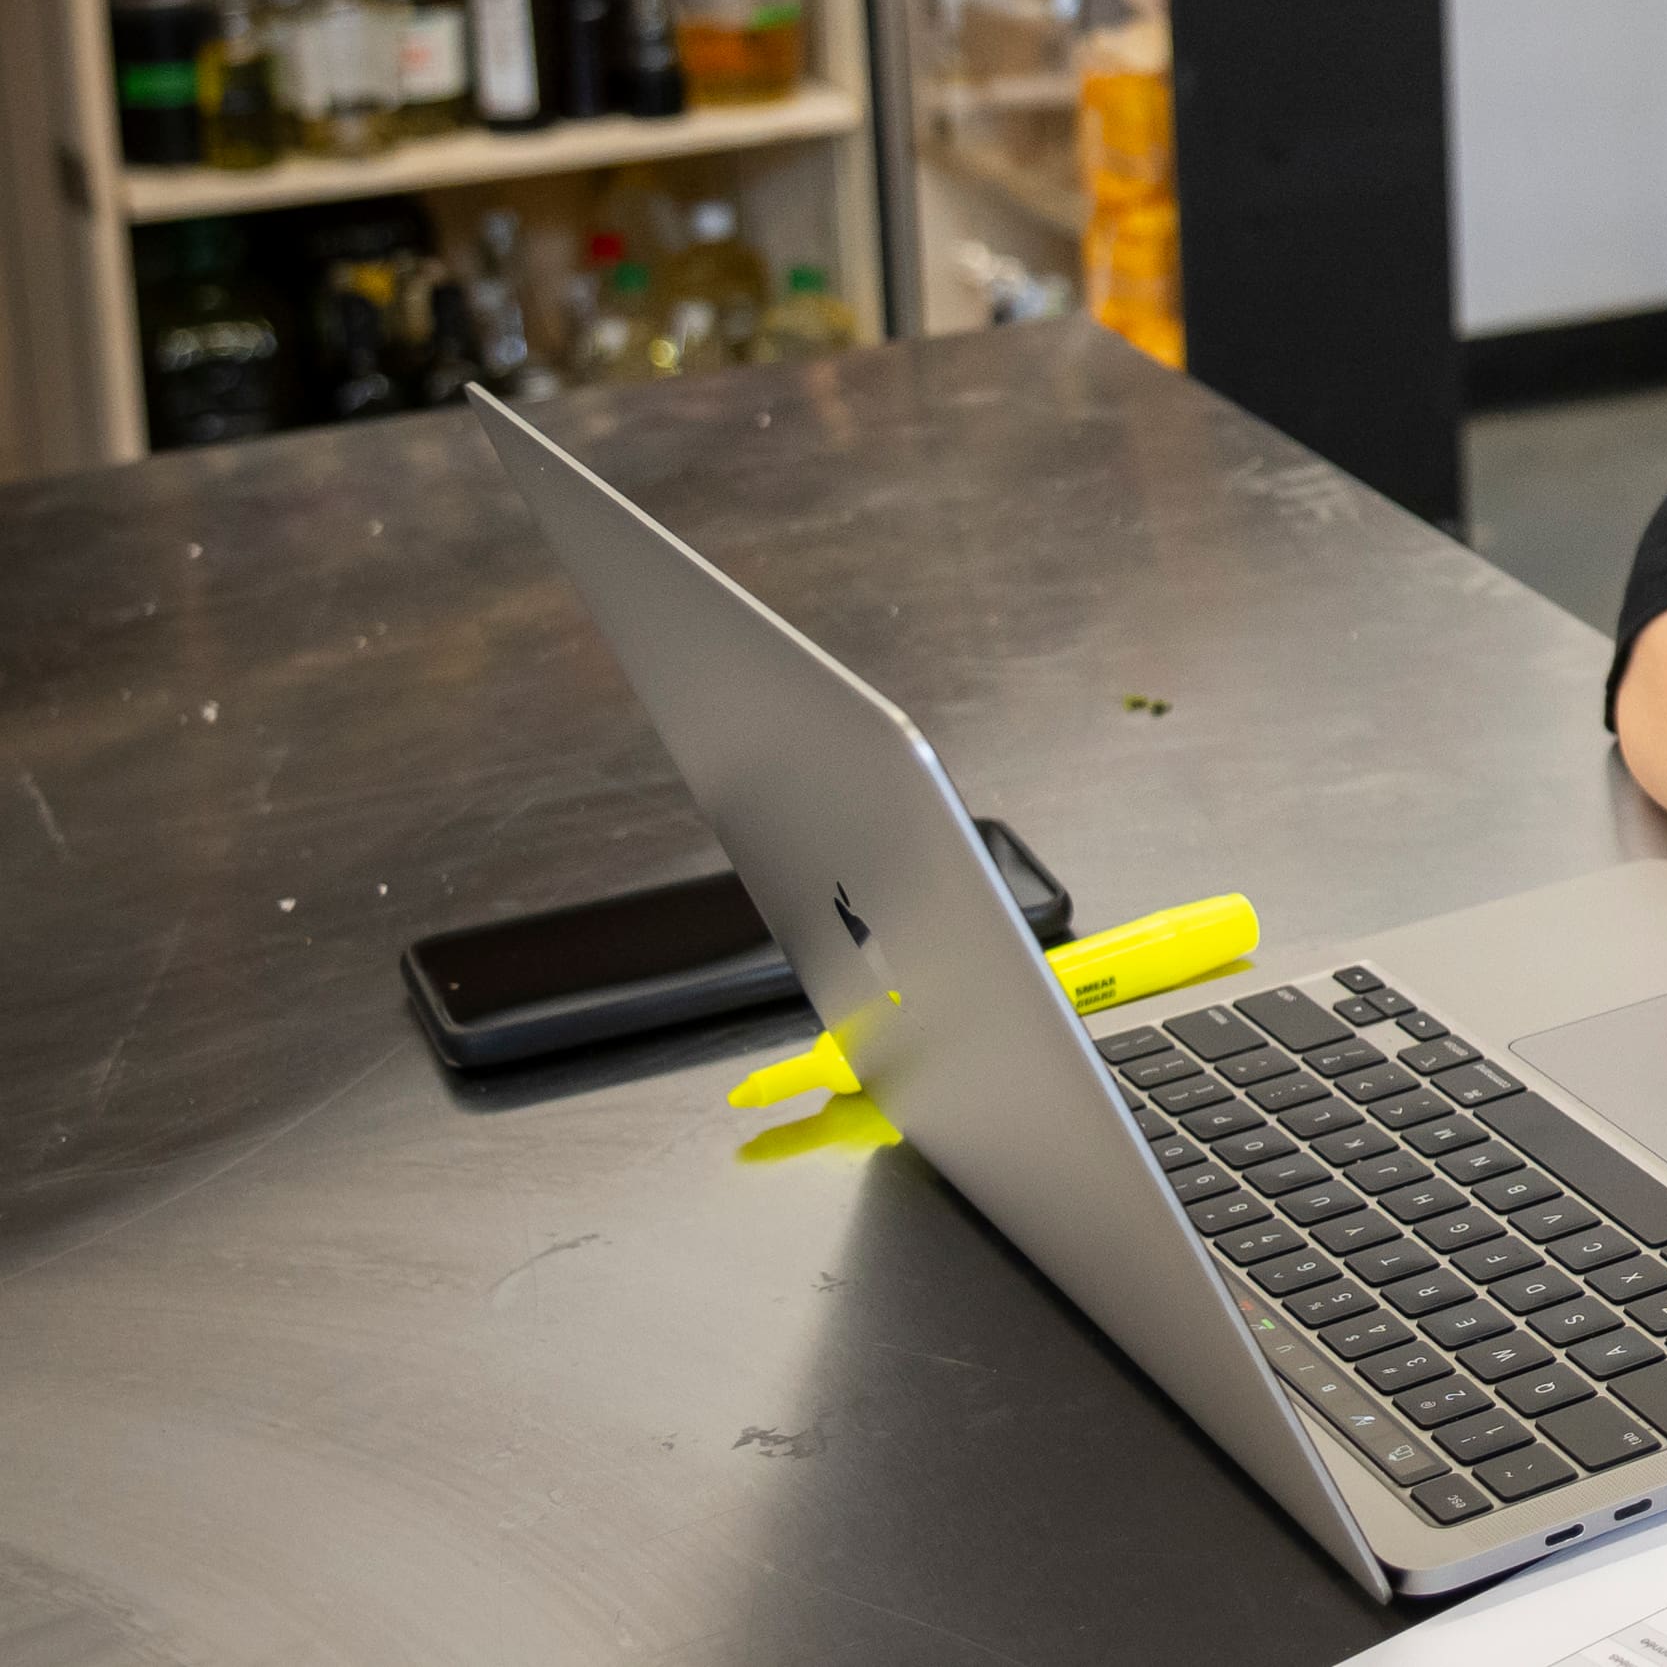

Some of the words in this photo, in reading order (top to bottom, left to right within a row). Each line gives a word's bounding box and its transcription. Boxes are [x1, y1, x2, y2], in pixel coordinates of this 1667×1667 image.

[1075, 976, 1116, 997] SMEAR
[1315, 1112, 1330, 1121] L
[1434, 1128, 1456, 1139] M
[1344, 1139, 1364, 1148] K
[1470, 1156, 1490, 1166] N
[1378, 1165, 1398, 1174] J
[1196, 1175, 1215, 1184] 9
[1507, 1185, 1527, 1194] B
[1310, 1197, 1330, 1206] U
[1413, 1194, 1434, 1204] H
[1229, 1204, 1247, 1212] 8
[1543, 1215, 1562, 1224] V
[1345, 1227, 1364, 1236] Y
[1450, 1224, 1469, 1232] G
[1583, 1243, 1602, 1252] C
[1381, 1256, 1401, 1266] T
[1486, 1254, 1508, 1263] F
[1297, 1262, 1316, 1271] 6
[1621, 1273, 1642, 1283] X
[1419, 1286, 1439, 1296] R
[1526, 1284, 1546, 1294] D
[1332, 1293, 1352, 1302] 5
[1456, 1318, 1476, 1327] E
[1565, 1315, 1584, 1324] S
[1368, 1324, 1387, 1333] 4
[1606, 1346, 1626, 1355] A
[1491, 1349, 1517, 1363] W
[1407, 1357, 1426, 1366] 3
[1535, 1382, 1555, 1393] Q
[1445, 1390, 1466, 1400] 2
[1485, 1425, 1505, 1435] 1
[1624, 1432, 1643, 1446] tab
[1447, 1494, 1466, 1510] esc
